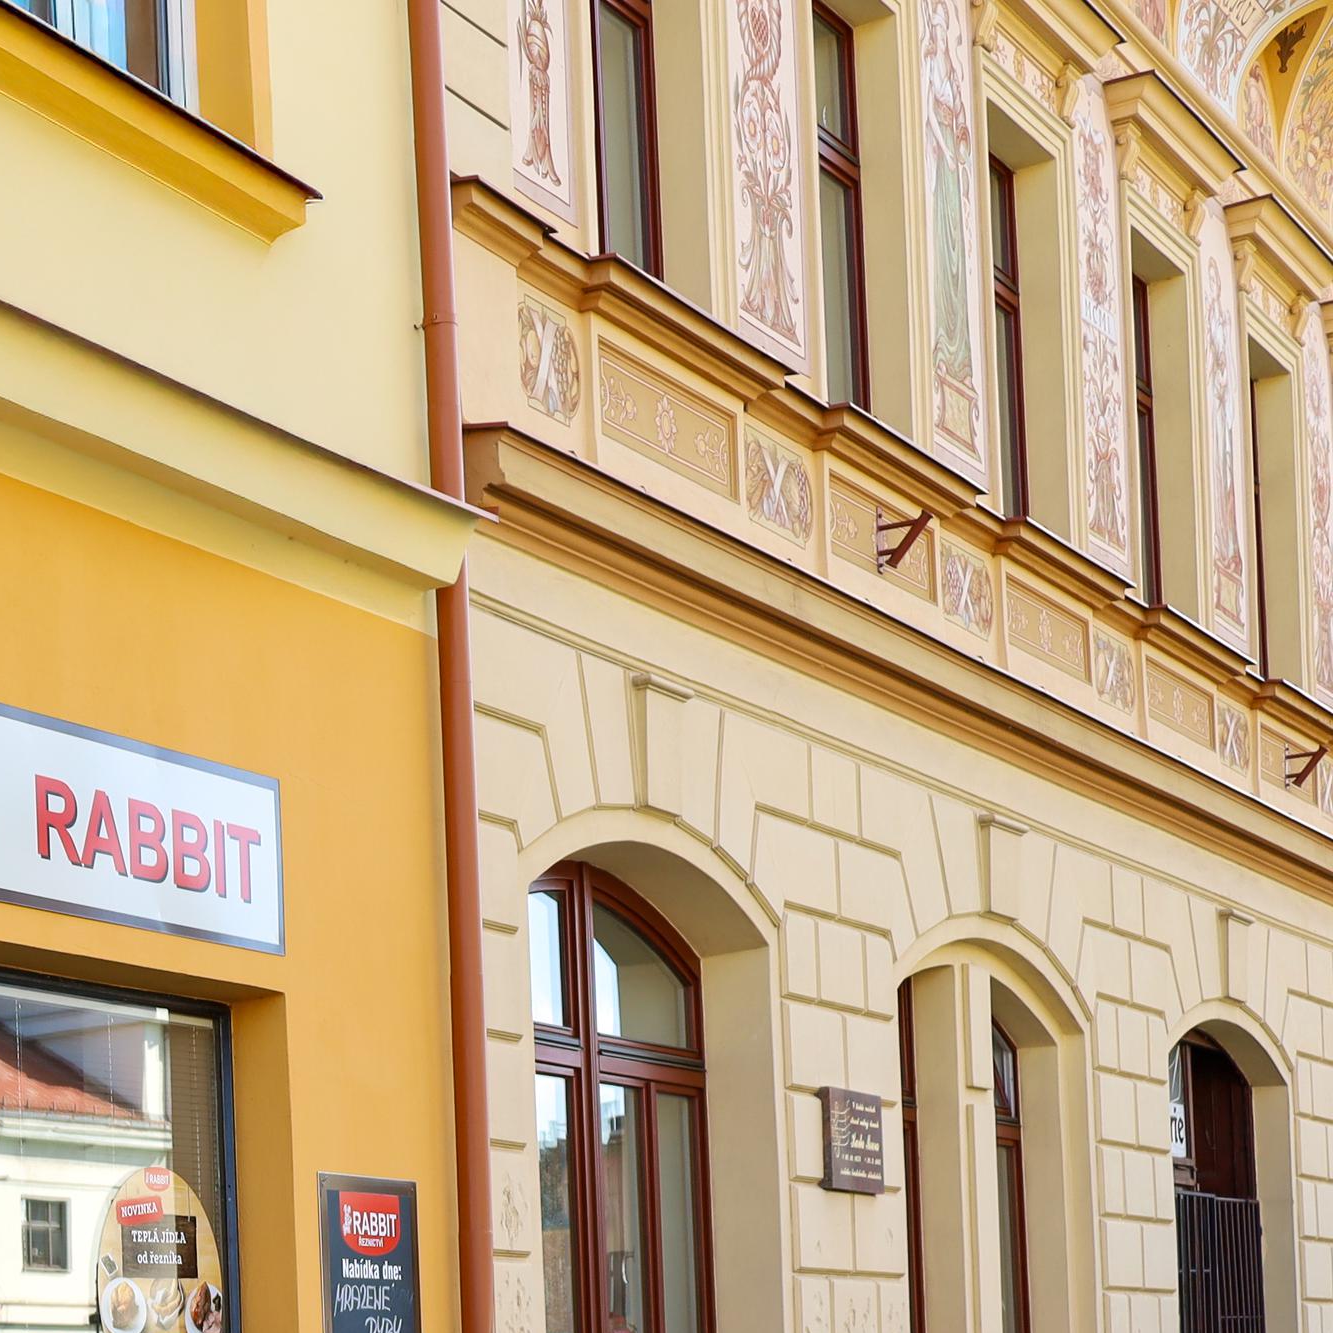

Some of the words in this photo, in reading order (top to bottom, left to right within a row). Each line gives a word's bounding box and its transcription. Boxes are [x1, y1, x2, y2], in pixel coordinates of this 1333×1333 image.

[35, 774, 262, 903] RABBIT
[121, 1202, 158, 1217] NOVINKA
[353, 1211, 397, 1238] RABBIT
[132, 1228, 160, 1243] TEPLÁ
[161, 1229, 186, 1244] JÍDLA
[137, 1251, 148, 1264] od
[149, 1250, 182, 1264] řezníka
[342, 1258, 380, 1280] Nabídka
[382, 1261, 402, 1281] dne:
